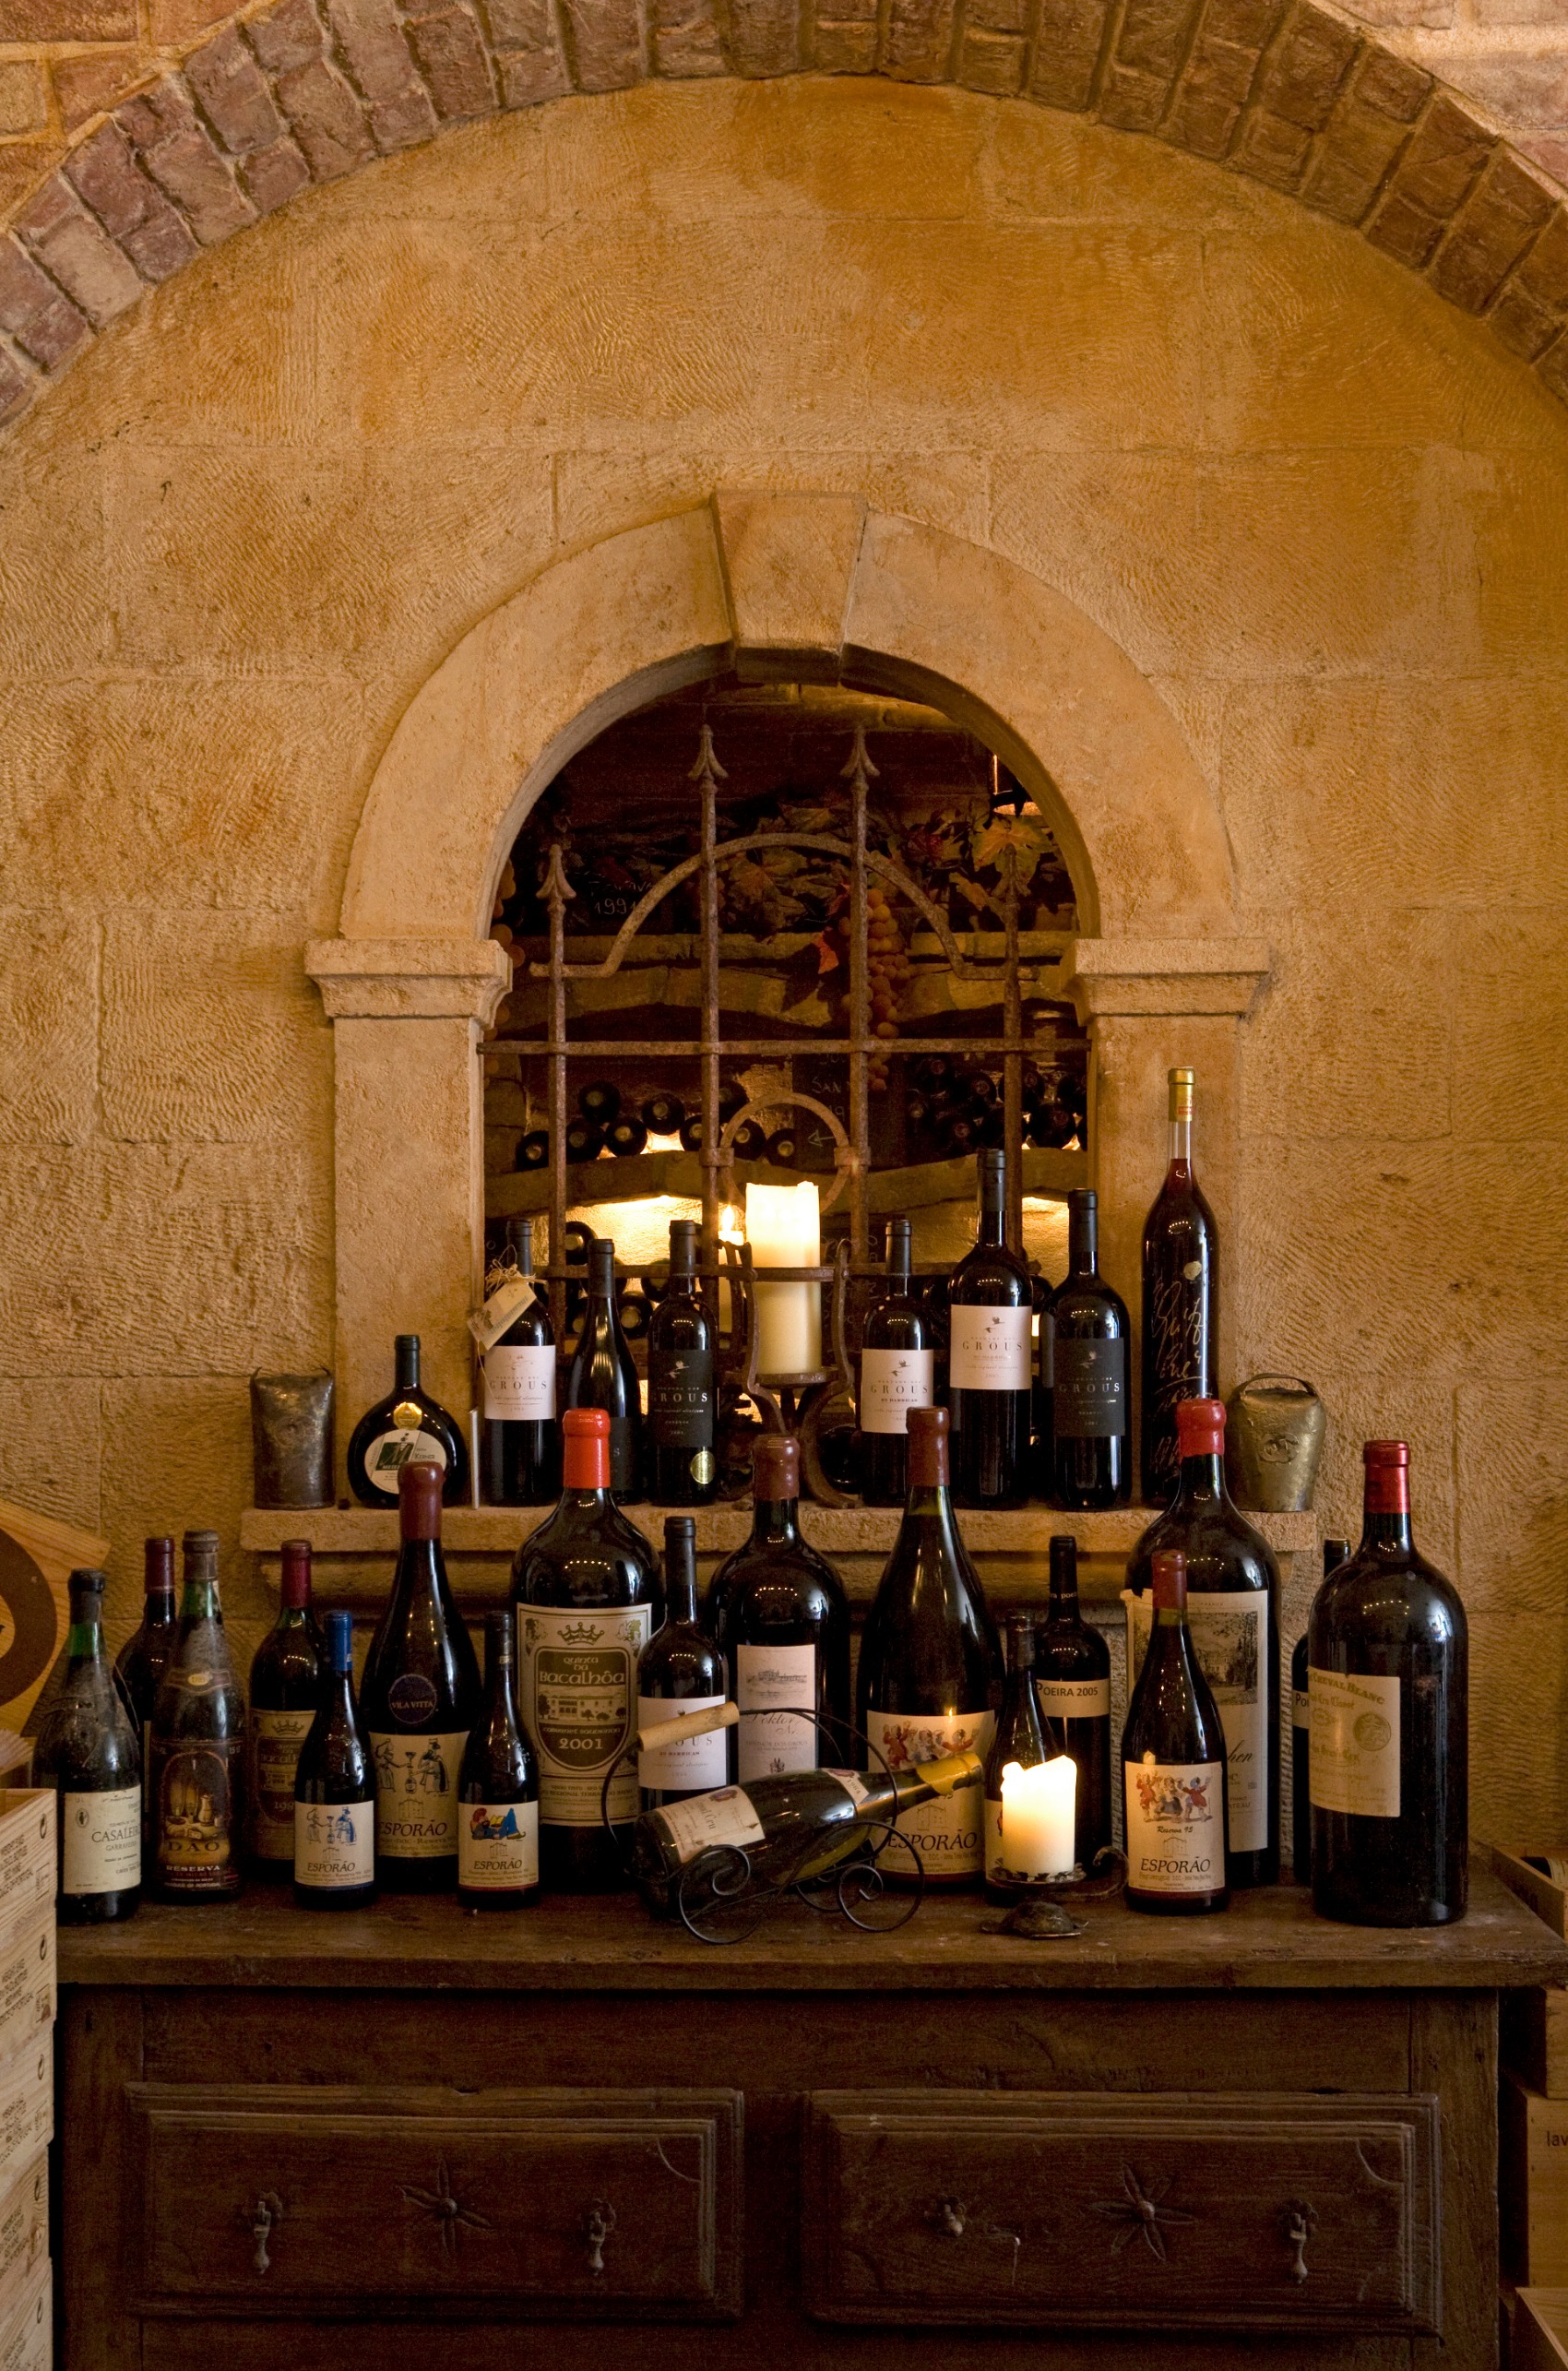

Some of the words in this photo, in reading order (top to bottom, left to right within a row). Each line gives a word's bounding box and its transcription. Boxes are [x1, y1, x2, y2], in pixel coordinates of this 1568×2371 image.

[962, 1340, 1023, 1352] GROUS
[490, 1380, 547, 1390] GROUS
[870, 1385, 928, 1394] GROUS
[540, 1670, 625, 1685] Bacalhôa
[1076, 1686, 1099, 1697] 2005
[392, 1700, 410, 1710] VILA
[411, 1699, 434, 1709] VITTA
[558, 1737, 603, 1750] 2001
[377, 1819, 448, 1838] ESPORÃO
[887, 1829, 978, 1852] ESPORÃO
[307, 1860, 356, 1873] ESPORÃO
[473, 1857, 523, 1871] ESPORÃO
[1140, 1856, 1211, 1874] ESPORÃO
[1547, 2130, 1568, 2147] lav
